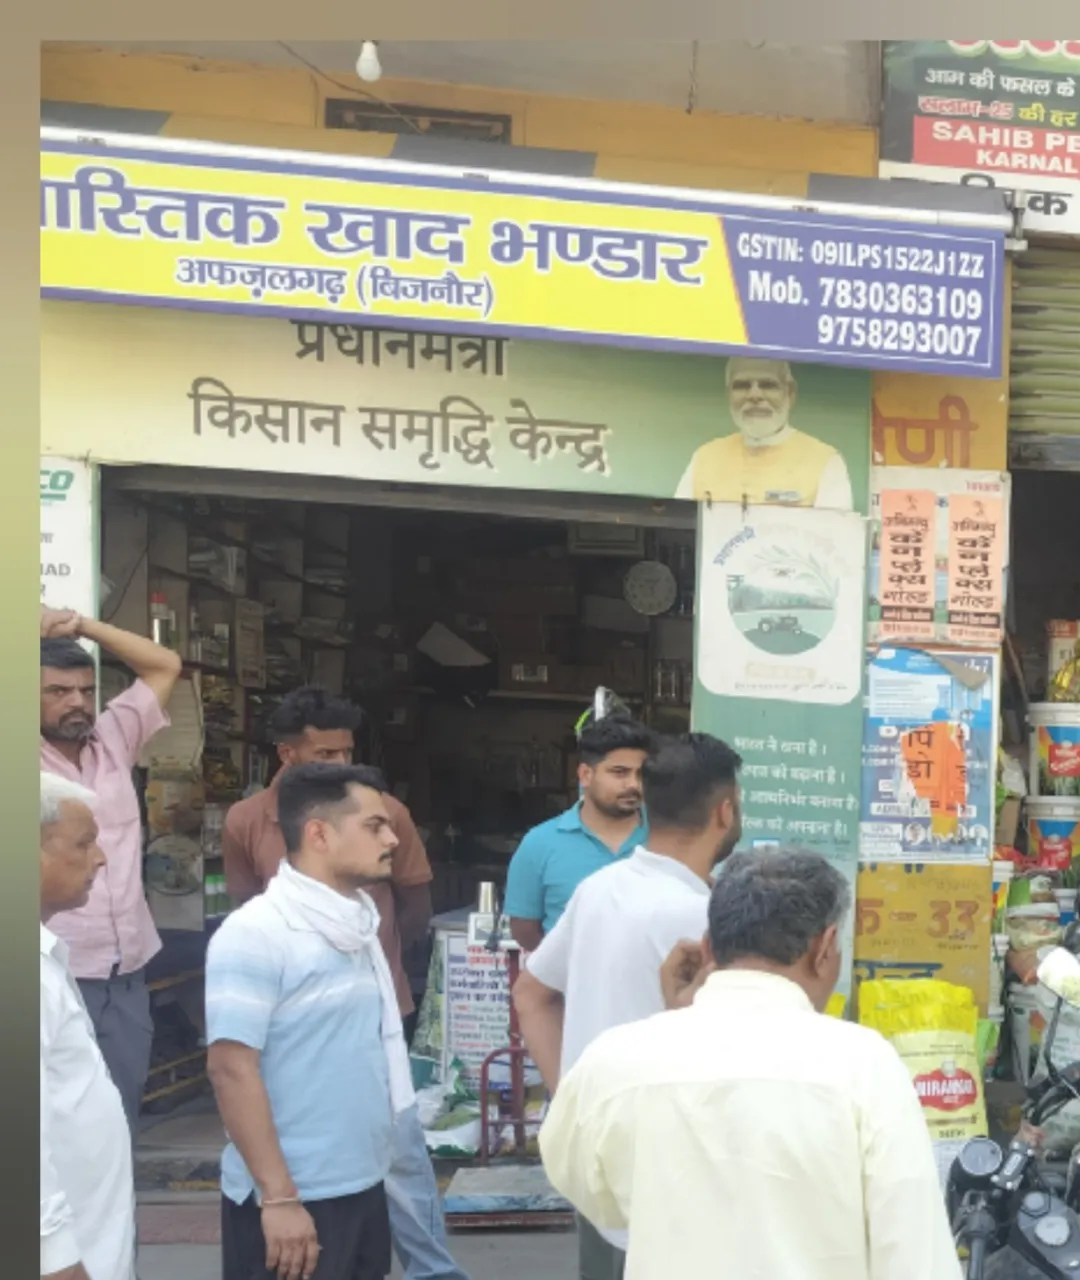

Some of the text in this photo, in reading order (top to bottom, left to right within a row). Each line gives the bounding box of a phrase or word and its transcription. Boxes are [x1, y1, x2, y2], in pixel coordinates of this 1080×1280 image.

[925, 68, 965, 85] आम
[969, 67, 995, 90] की
[1000, 76, 1052, 96] फसल
[1056, 77, 1076, 98] के
[1019, 103, 1045, 121] की
[932, 121, 1034, 149] SAHIB
[976, 149, 1078, 174] KARNAL
[306, 202, 470, 267] खाद
[490, 216, 707, 288] भण्डार
[737, 232, 984, 279] GSTIN: 09ILPS1522J1ZZ
[356, 266, 496, 318] (बिजनौर)
[748, 270, 982, 321] Mob. 7830363109
[817, 313, 982, 357] 9758293007
[186, 376, 612, 476] किसान समृद्धि केन्द्र
